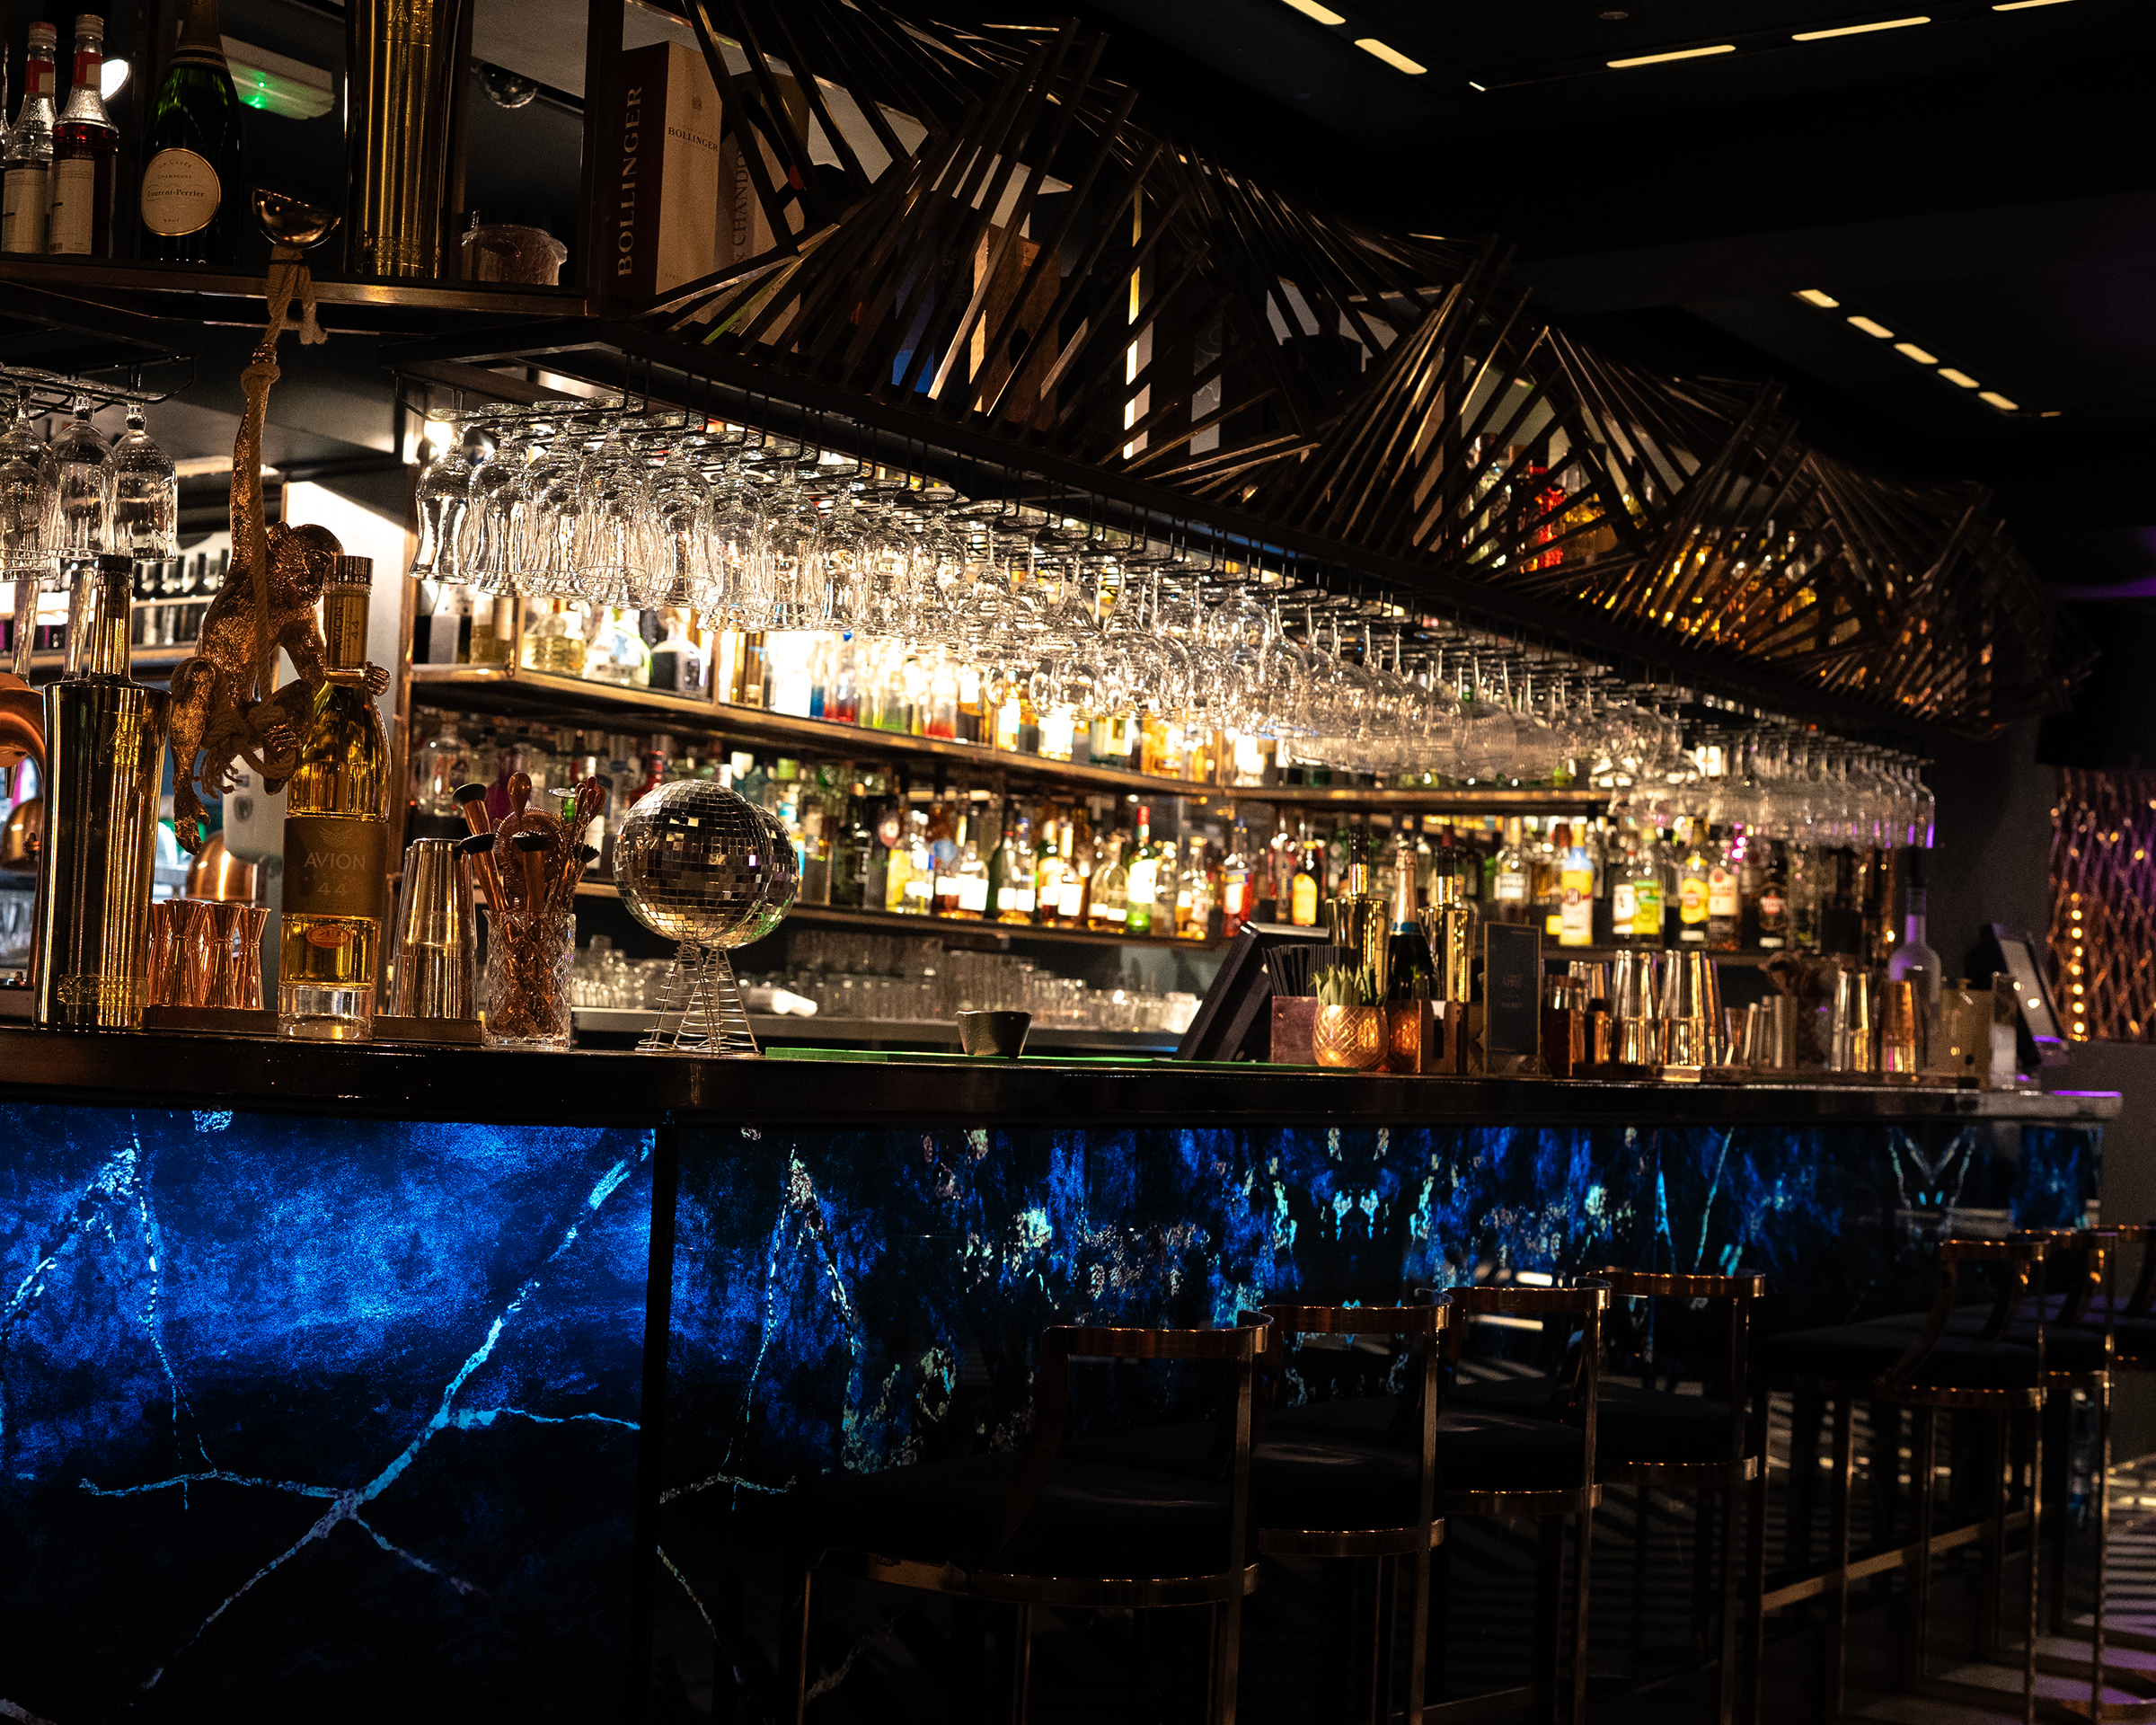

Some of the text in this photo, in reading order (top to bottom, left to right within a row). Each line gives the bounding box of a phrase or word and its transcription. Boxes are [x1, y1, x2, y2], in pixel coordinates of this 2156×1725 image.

[668, 127, 719, 152] BOLLINGER
[147, 189, 205, 197] Laurent-Perrier
[618, 85, 642, 277] BOLLINGER
[732, 149, 749, 246] CHANDO
[316, 881, 348, 897] 44
